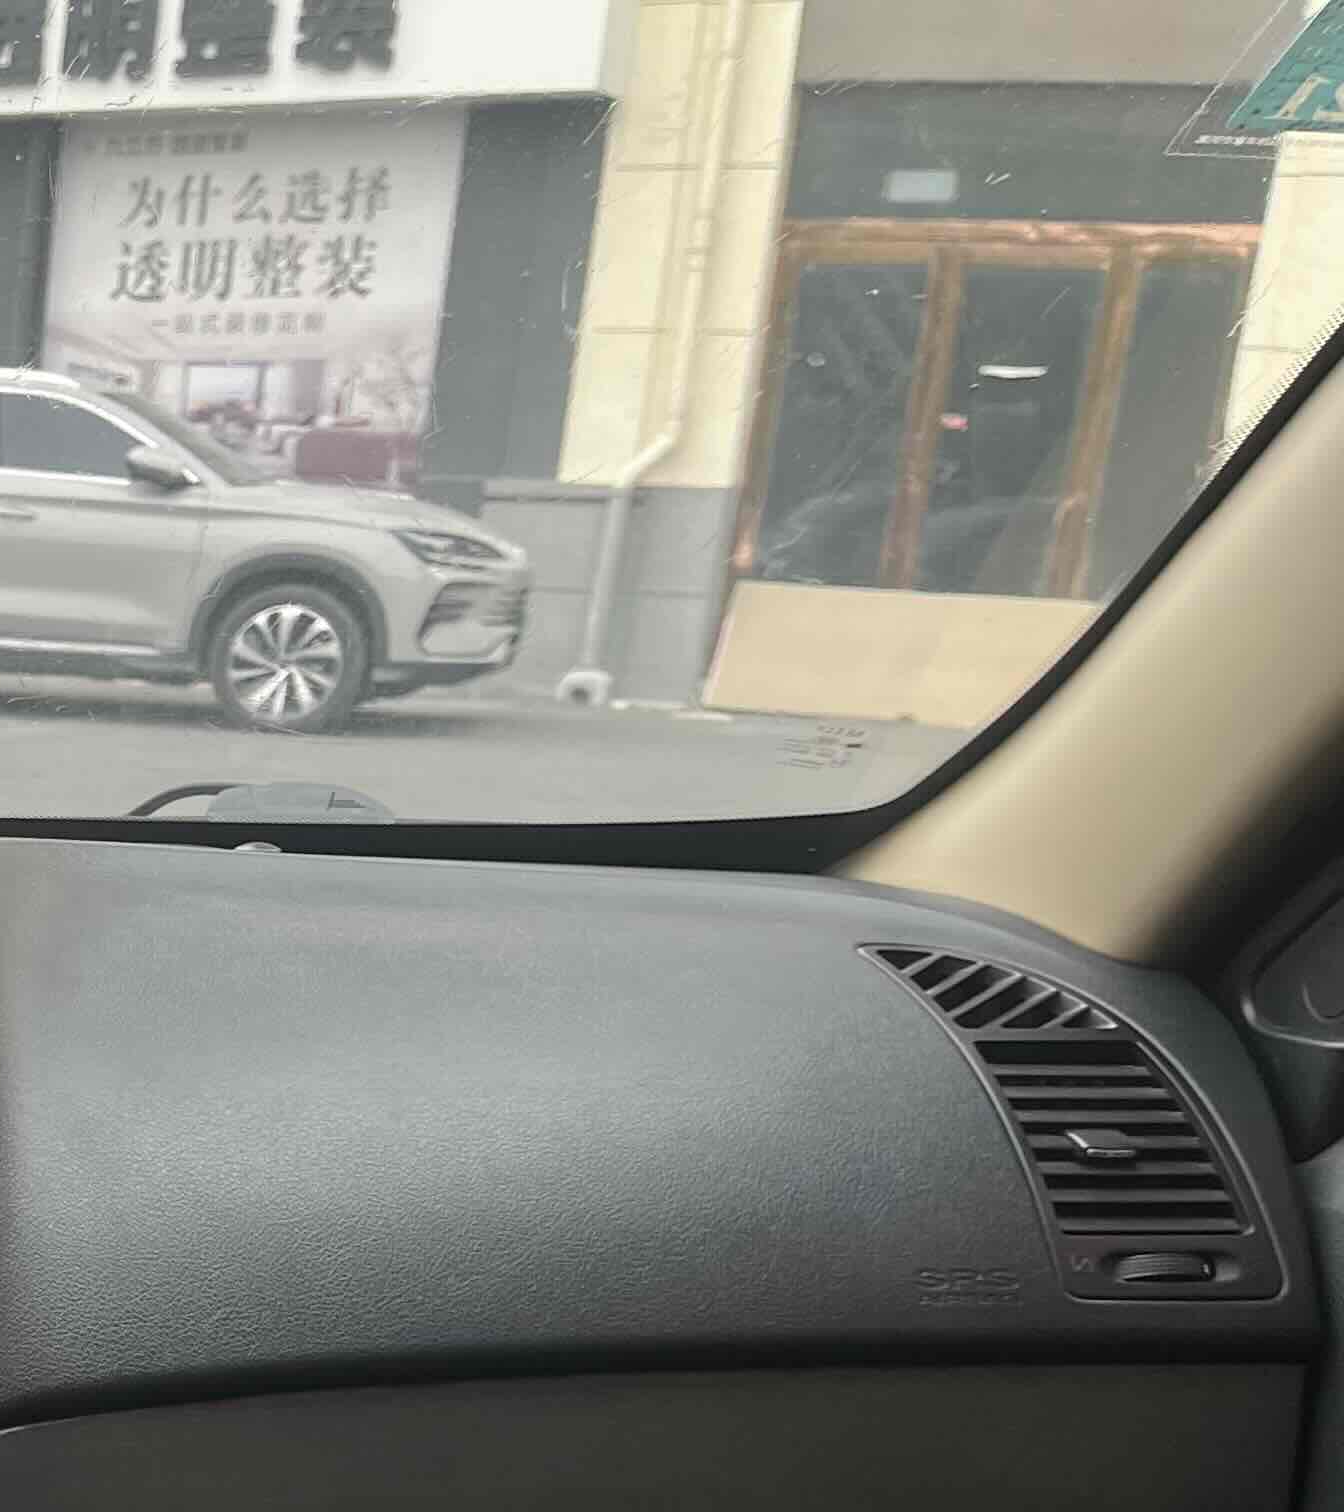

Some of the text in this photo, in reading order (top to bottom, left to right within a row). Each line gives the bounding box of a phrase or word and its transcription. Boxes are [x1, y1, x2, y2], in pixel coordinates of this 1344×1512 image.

[117, 165, 392, 228] 为什么选择
[109, 234, 379, 303] 透明整装
